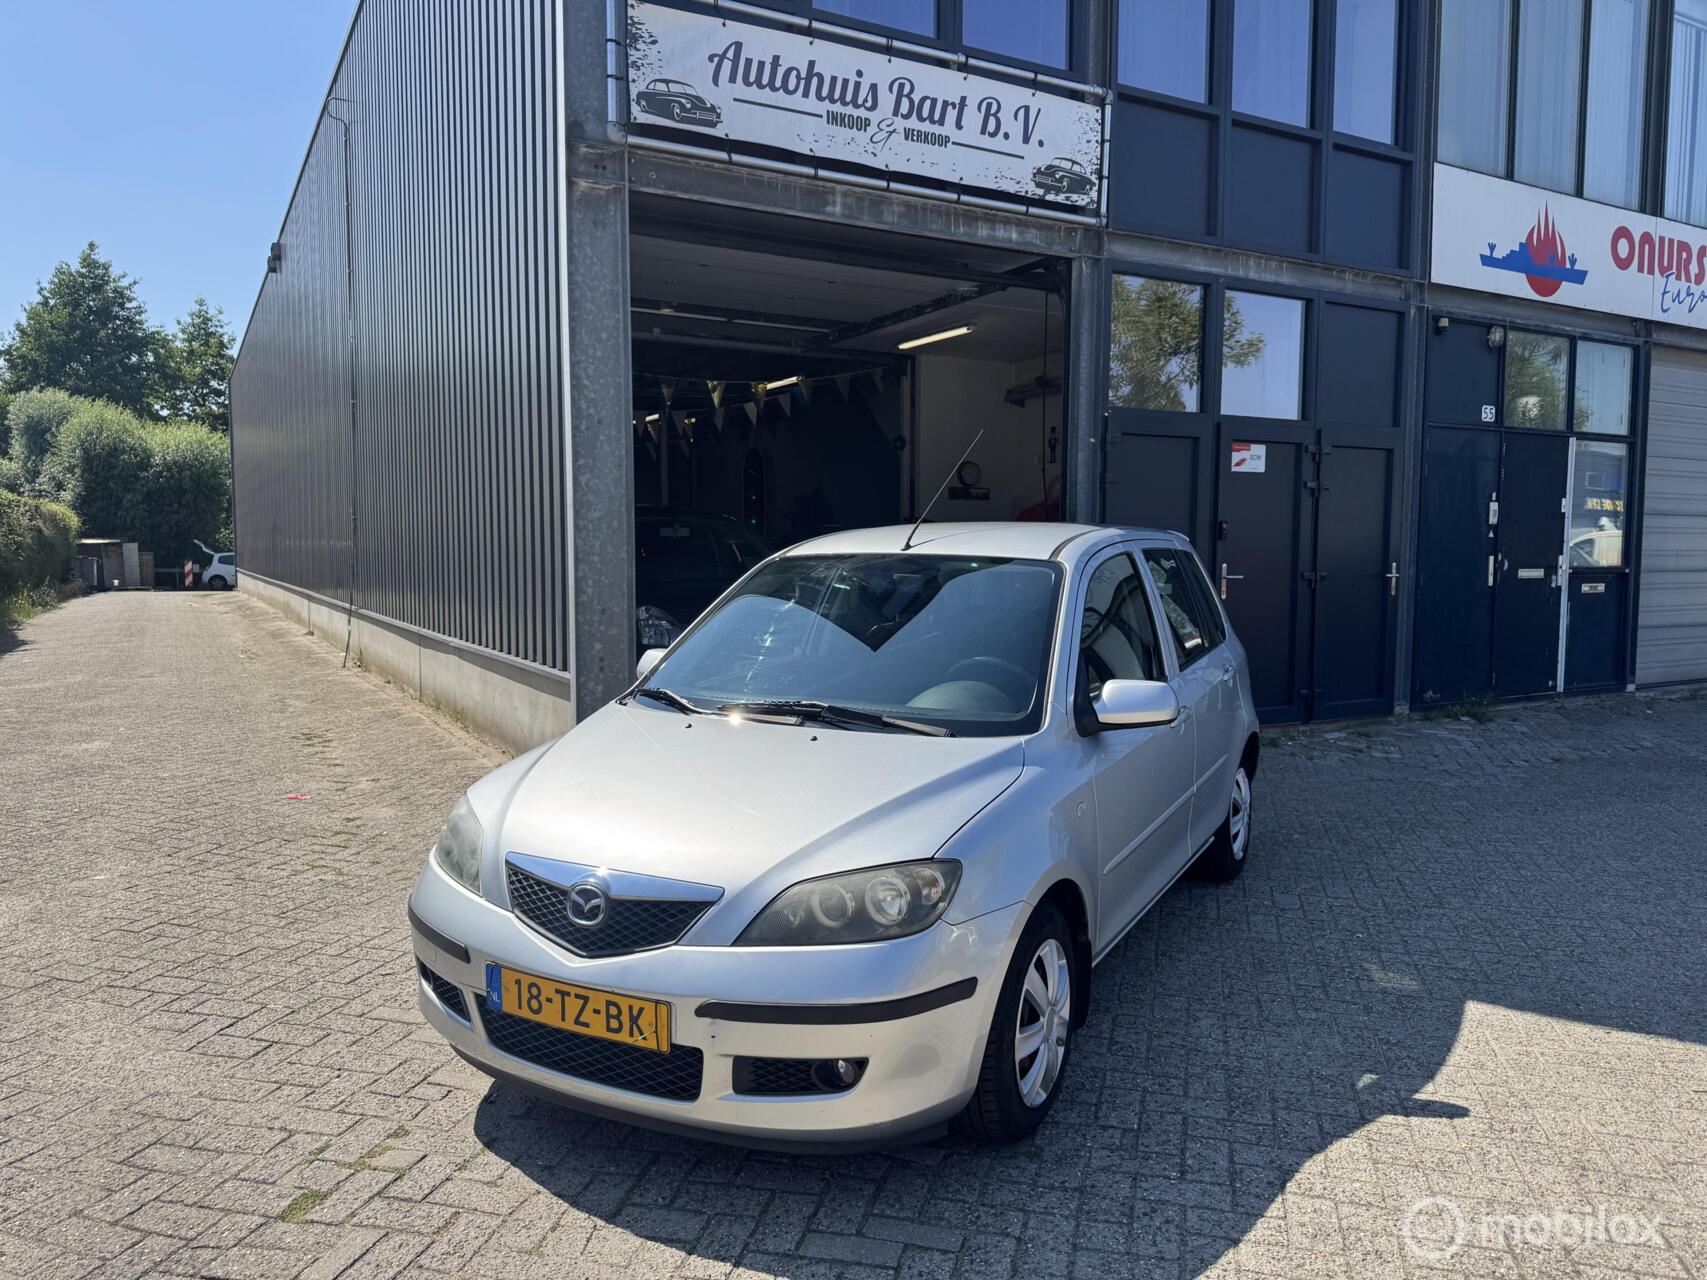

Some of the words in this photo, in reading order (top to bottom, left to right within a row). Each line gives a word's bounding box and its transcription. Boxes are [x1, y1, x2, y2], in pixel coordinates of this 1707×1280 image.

[707, 41, 878, 113] Autohuis
[888, 77, 967, 130] Bart
[977, 98, 1045, 148] B.V.
[826, 109, 871, 133] INKOOP
[870, 117, 900, 153] &
[903, 126, 951, 148] VERKOOP
[1483, 406, 1494, 420] 55
[489, 990, 500, 1003] NL
[514, 977, 648, 1041] 18-TZ-BK
